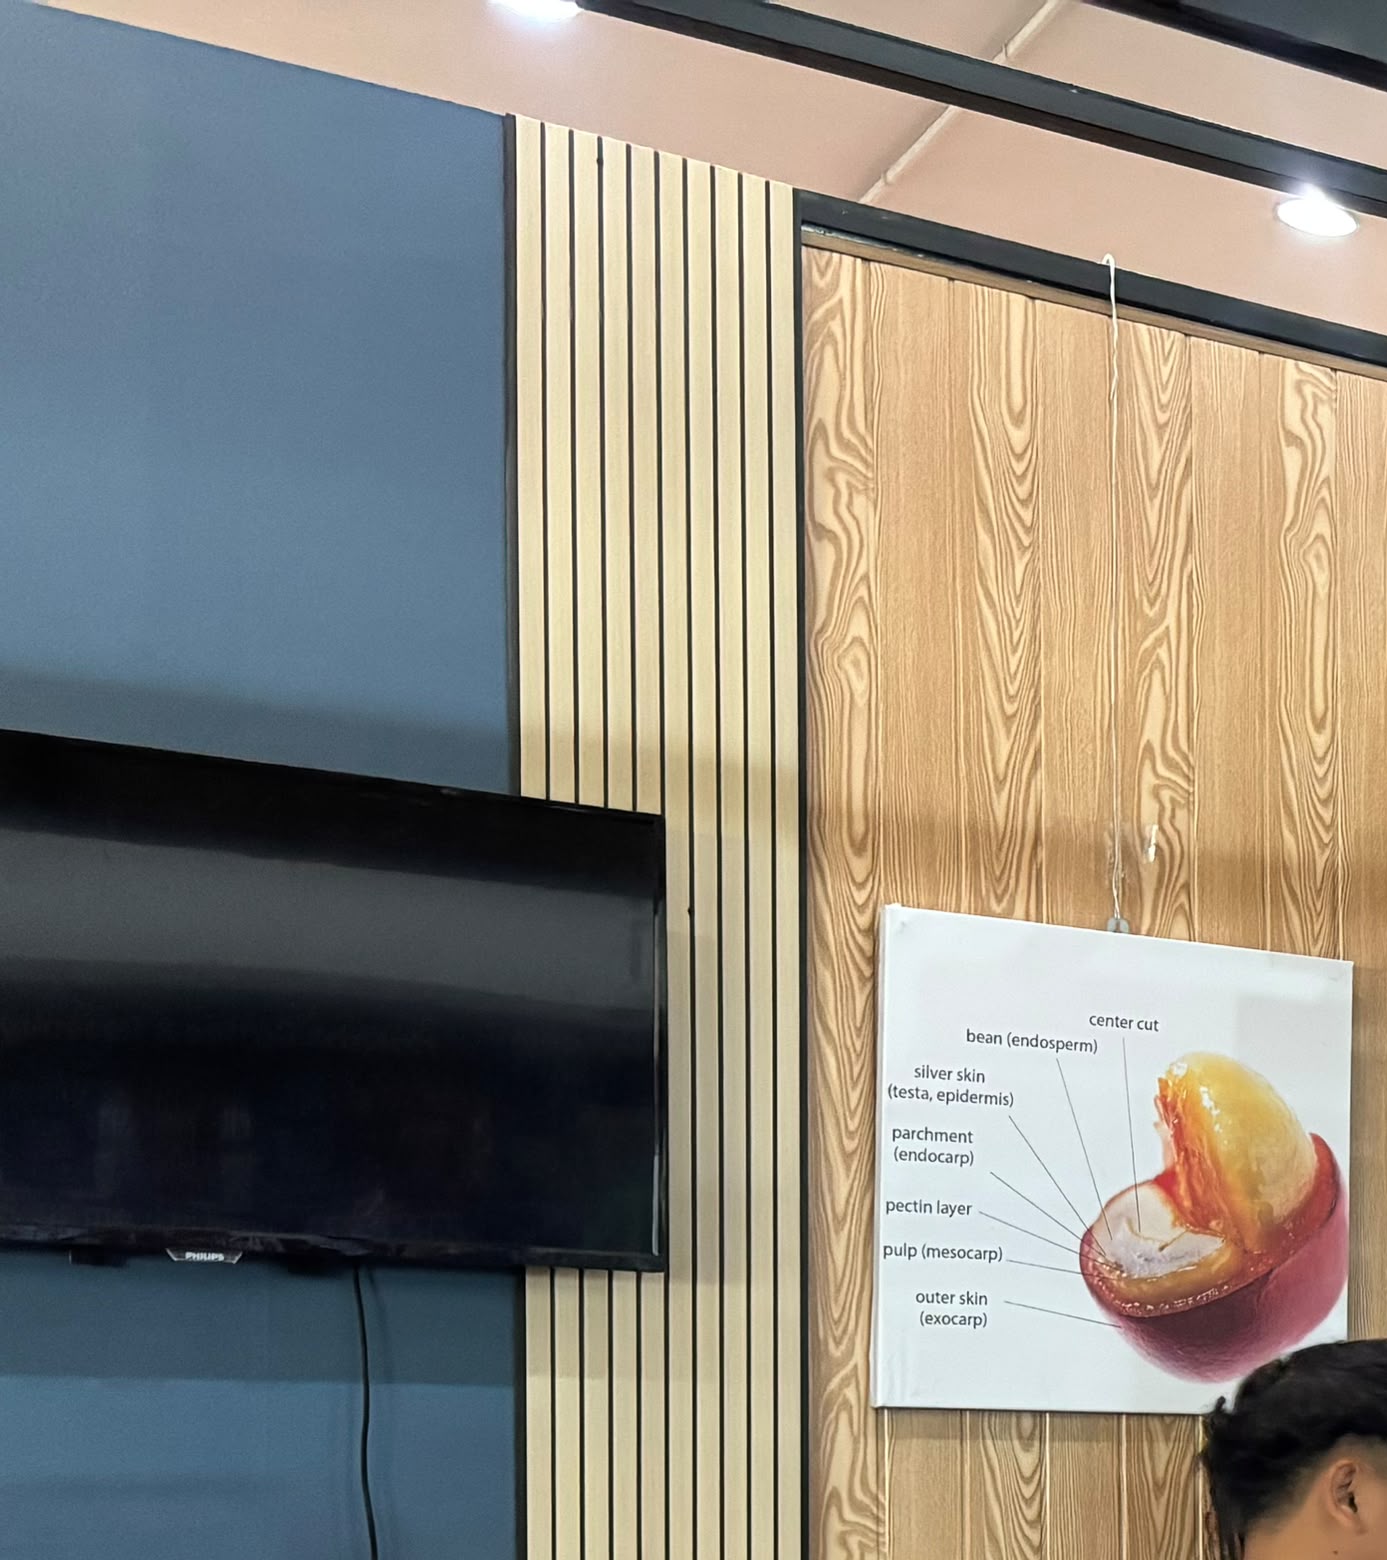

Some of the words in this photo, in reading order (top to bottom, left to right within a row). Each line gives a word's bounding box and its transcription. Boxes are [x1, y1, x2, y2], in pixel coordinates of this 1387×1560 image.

[1089, 1015, 1134, 1029] center
[1137, 1018, 1159, 1032] cut
[967, 1028, 1002, 1045] bean
[1007, 1032, 1097, 1054] (endosperm)
[914, 1065, 953, 1080] silver
[957, 1067, 985, 1083] skin
[888, 1083, 933, 1102] (testa,
[937, 1089, 1014, 1108] epidermis)
[892, 1126, 973, 1144] parchment
[894, 1146, 974, 1167] (endocarp)
[886, 1199, 932, 1215] pectin
[937, 1200, 972, 1218] layer
[185, 1250, 225, 1262] PHILIPS
[883, 1242, 917, 1260] pulp
[922, 1244, 1003, 1264] (mesocarp)
[915, 1291, 955, 1305] outer
[959, 1291, 987, 1305] skin
[920, 1311, 987, 1329] (exocarp)
